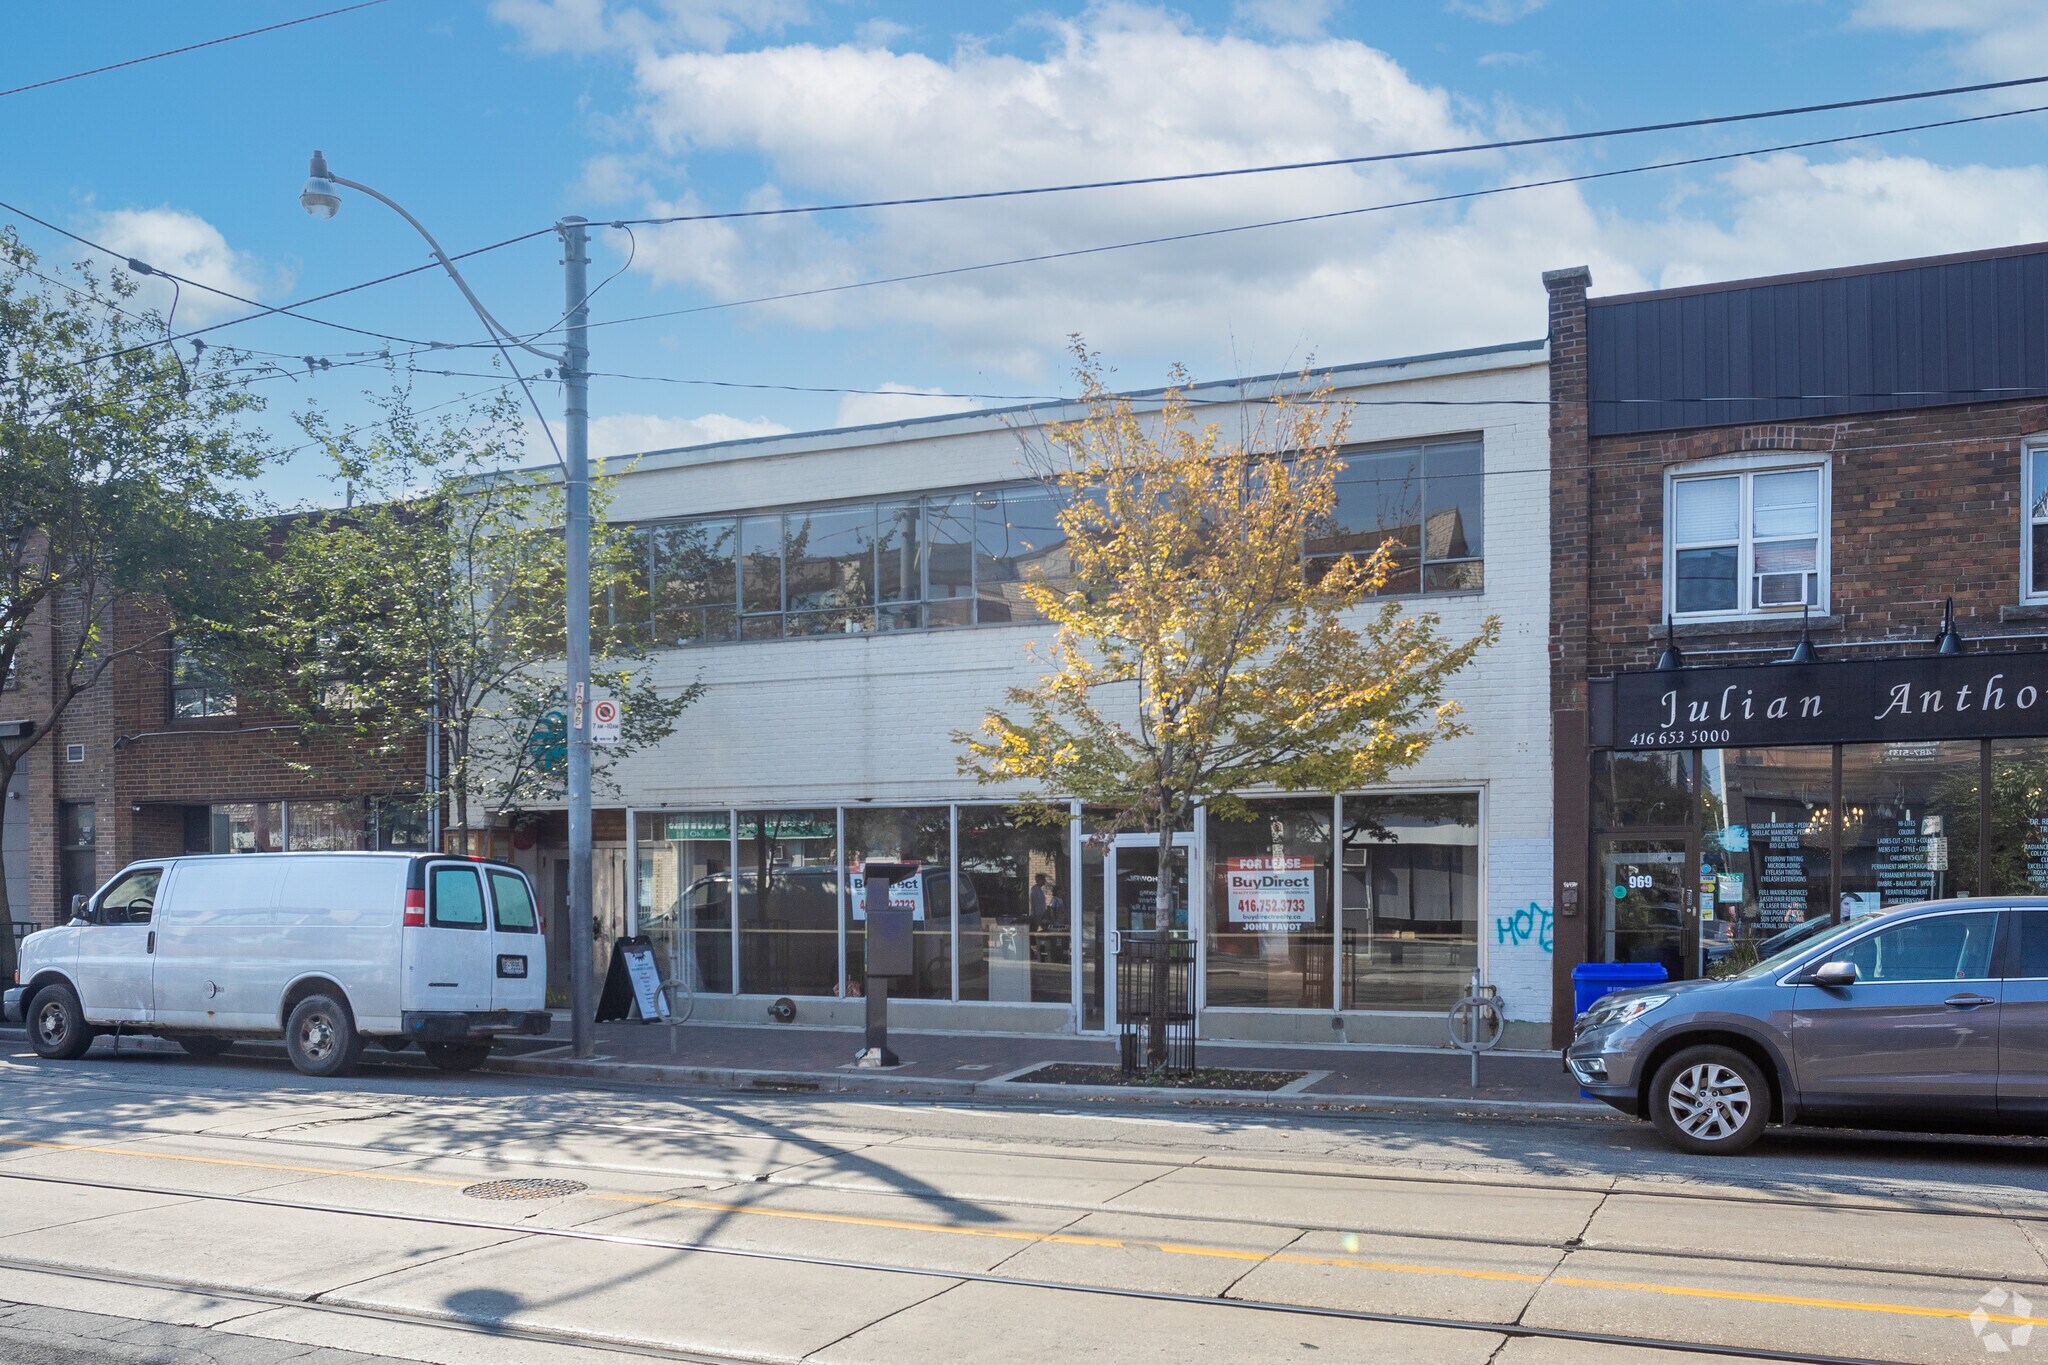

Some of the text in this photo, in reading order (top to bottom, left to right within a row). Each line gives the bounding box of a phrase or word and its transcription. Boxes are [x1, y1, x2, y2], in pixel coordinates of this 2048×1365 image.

[1661, 674, 2048, 729] Julian Antho
[1630, 729, 1730, 746] 416 653 5000
[1240, 859, 1301, 869] FOR LEASE
[1232, 875, 1310, 889] BuyDirect
[1629, 875, 1653, 889] 969
[1238, 899, 1305, 912] 416.752.3733
[1243, 923, 1302, 931] JOHN FAVOT
